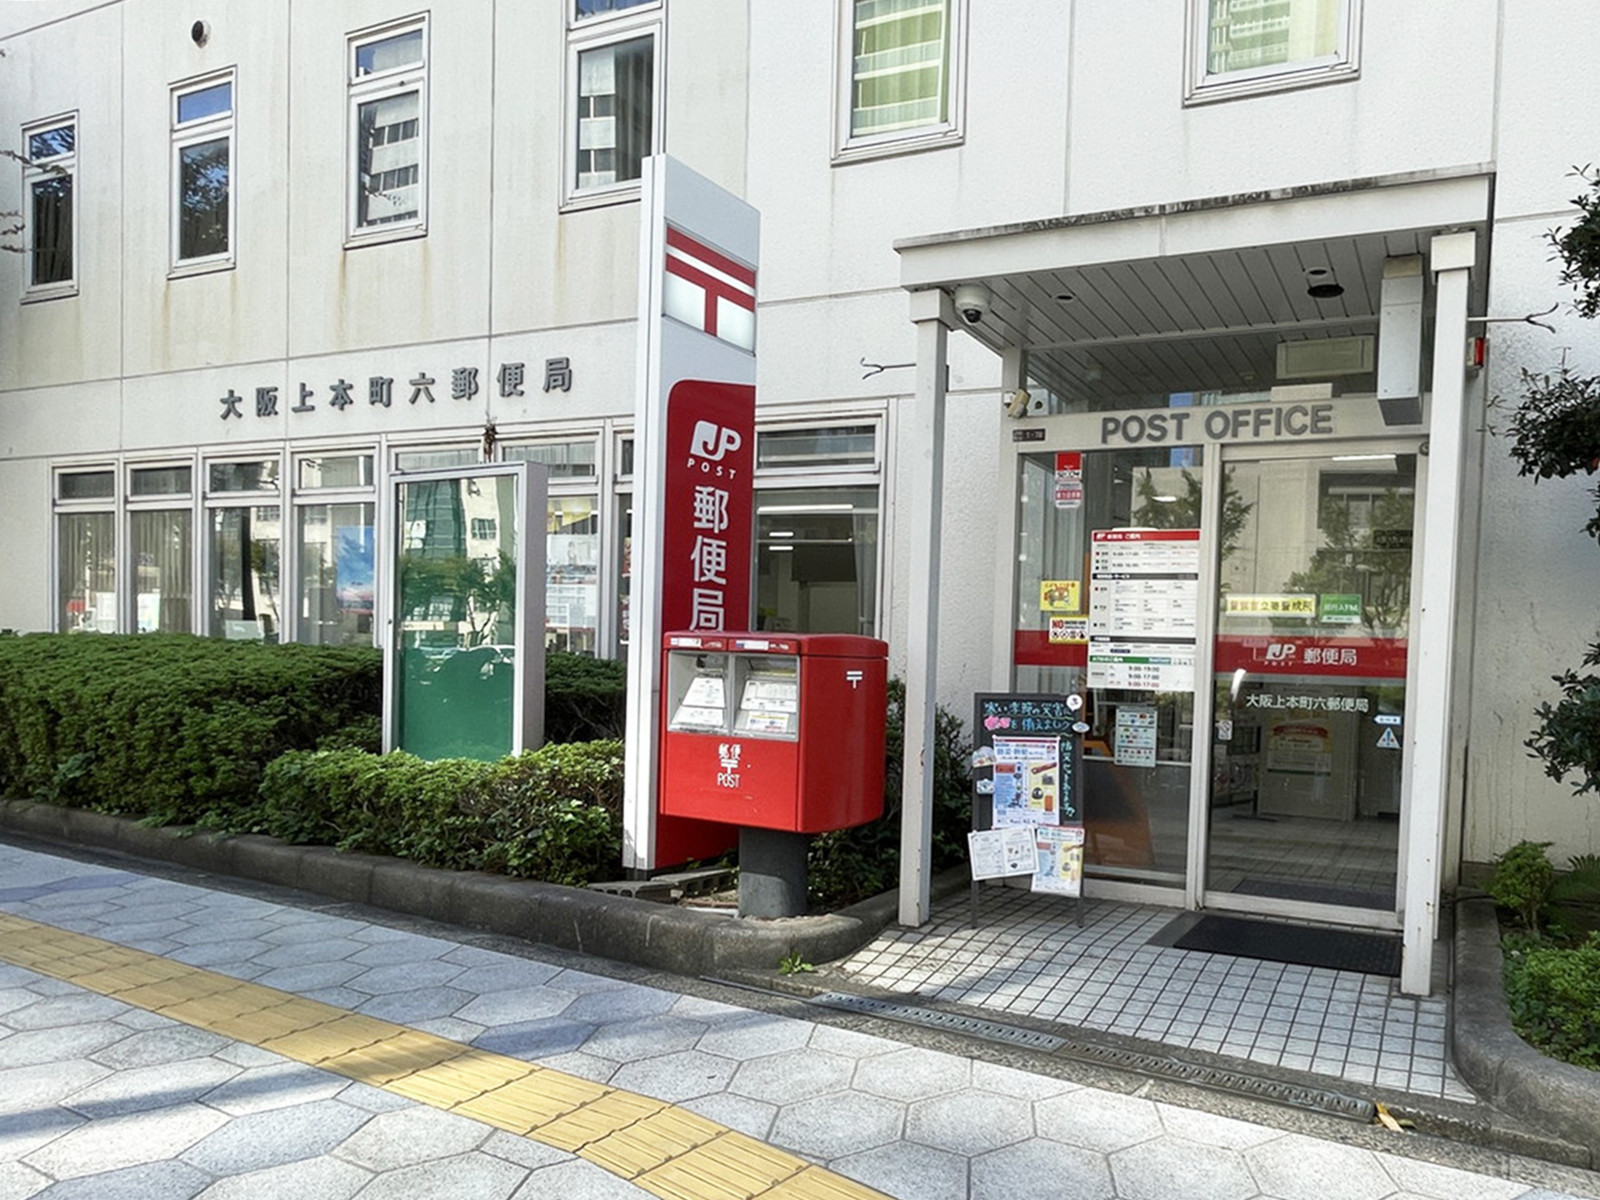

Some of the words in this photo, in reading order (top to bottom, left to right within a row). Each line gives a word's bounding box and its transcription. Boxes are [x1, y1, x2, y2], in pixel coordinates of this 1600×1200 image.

[219, 356, 574, 419] 大阪上本町六郵便局
[1100, 412, 1190, 444] POST
[1205, 404, 1333, 439] OFFICE
[690, 420, 742, 462] JP
[687, 457, 736, 480] POST
[689, 485, 729, 632] 郵便局
[1265, 643, 1297, 661] JP
[1304, 647, 1360, 667] 郵便局
[1246, 694, 1370, 713] 大阪上本町六郵便局
[718, 743, 742, 760] 郵便
[717, 773, 740, 788] POST
